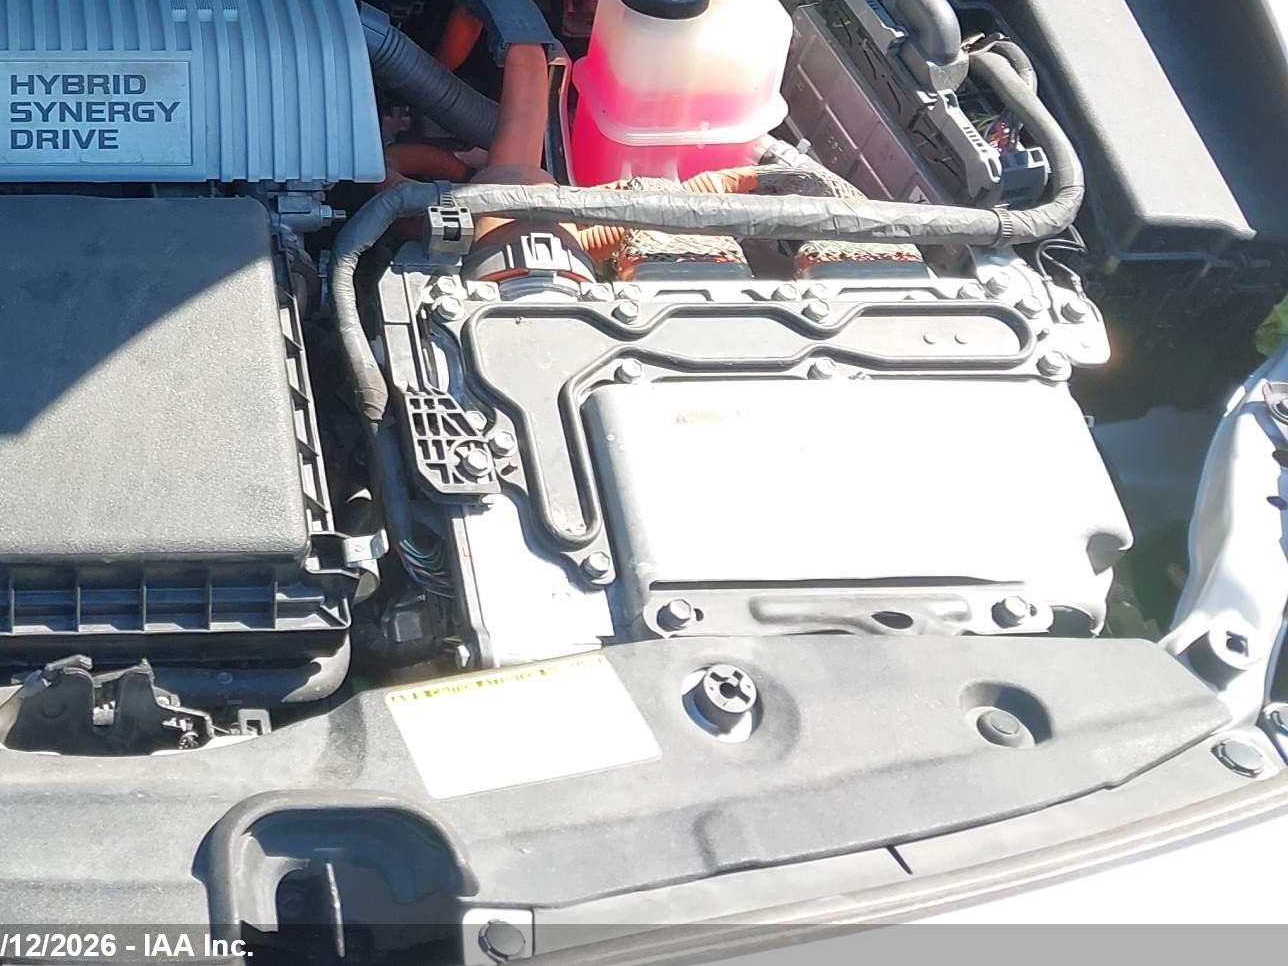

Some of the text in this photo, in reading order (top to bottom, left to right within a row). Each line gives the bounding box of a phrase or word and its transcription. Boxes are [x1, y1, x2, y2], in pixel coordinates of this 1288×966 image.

[10, 74, 147, 95] HYBRID
[10, 101, 181, 123] SYNERGY
[10, 128, 120, 150] DRIVE
